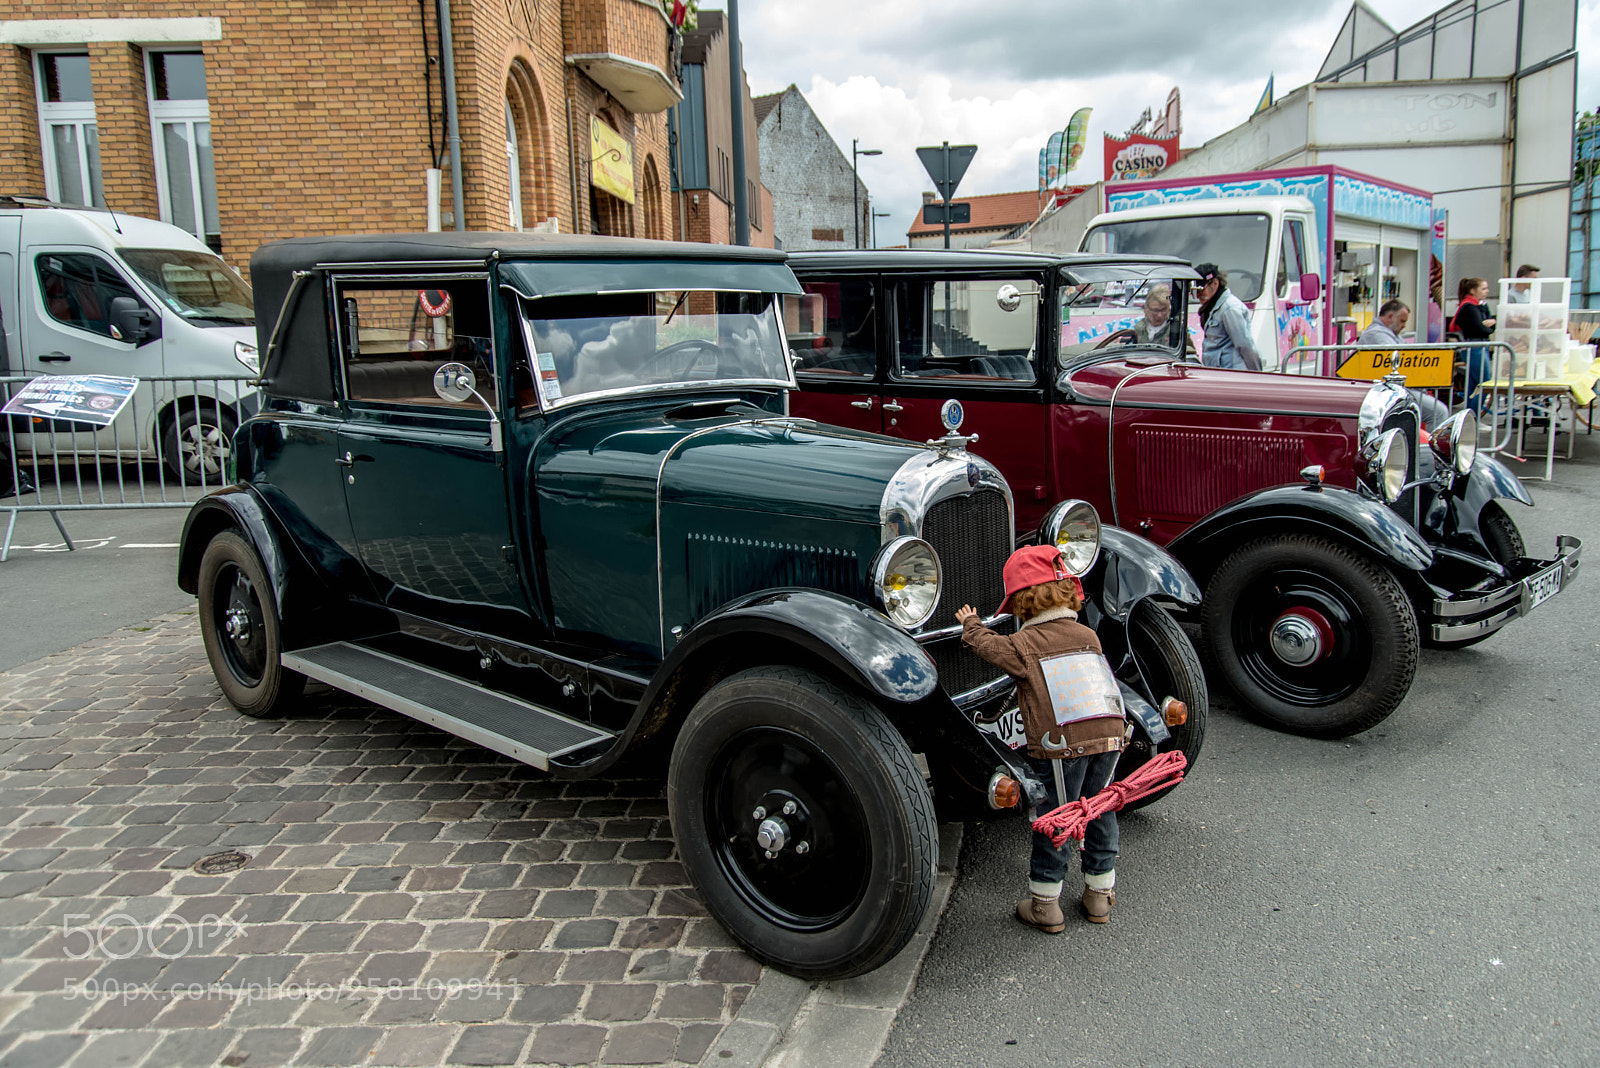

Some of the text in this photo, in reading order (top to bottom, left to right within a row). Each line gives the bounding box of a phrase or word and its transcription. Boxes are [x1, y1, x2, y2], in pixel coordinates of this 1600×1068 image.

[1115, 155, 1165, 172] CASINO
[1372, 353, 1440, 368] Déiation
[28, 382, 87, 393] VOITURES
[18, 392, 86, 403] MINIATURES
